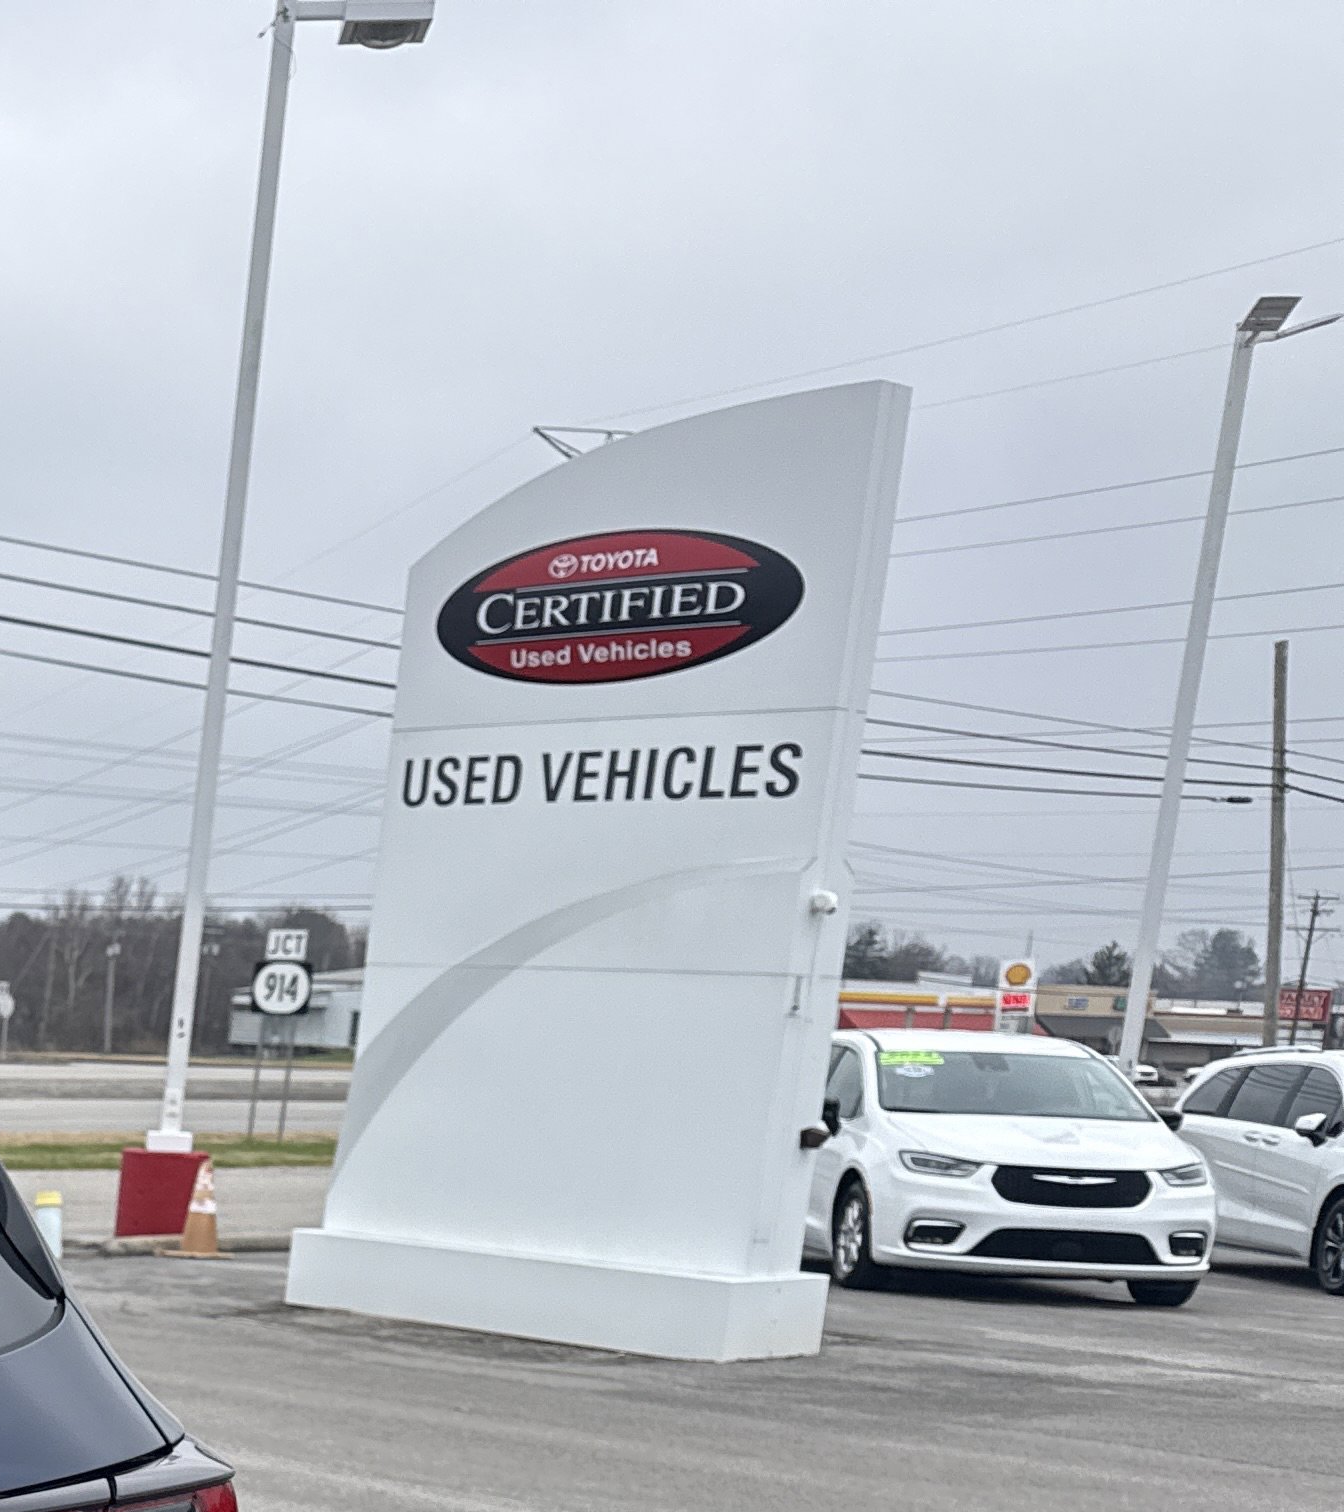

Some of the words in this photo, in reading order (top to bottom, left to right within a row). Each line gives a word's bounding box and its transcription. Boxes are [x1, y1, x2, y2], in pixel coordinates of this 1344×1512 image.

[579, 547, 659, 573] TOYOTA
[475, 580, 746, 636] CERTIFIED
[510, 647, 572, 670] Used
[577, 637, 693, 664] Vehicles
[402, 753, 523, 808] USED
[541, 741, 804, 804] VEHICLES
[268, 933, 304, 955] JCT
[263, 972, 300, 1002] 914
